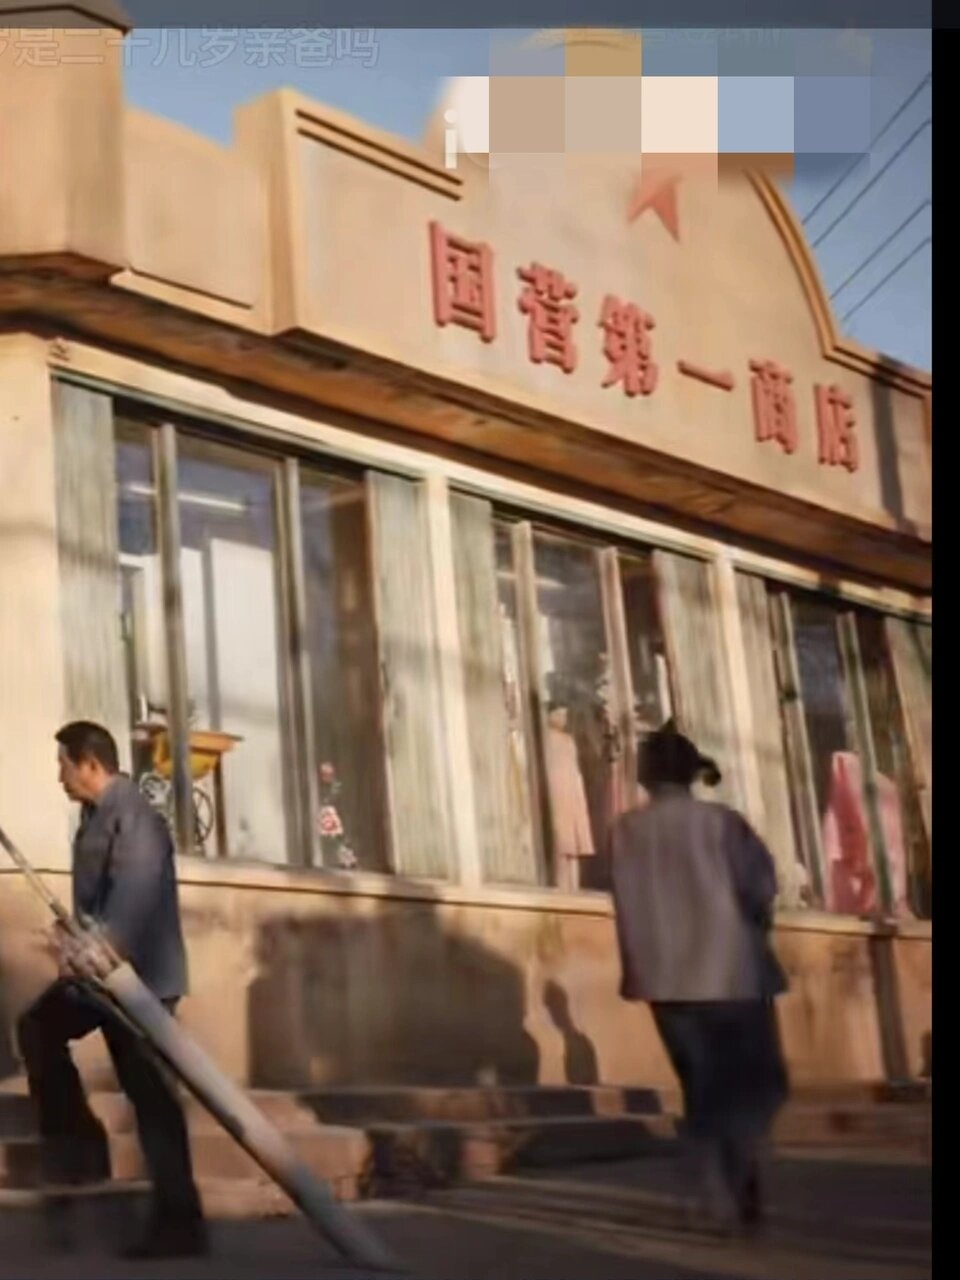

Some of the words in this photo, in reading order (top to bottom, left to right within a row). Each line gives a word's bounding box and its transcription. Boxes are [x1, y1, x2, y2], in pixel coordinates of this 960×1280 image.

[428, 219, 858, 473] 国营第一商店
